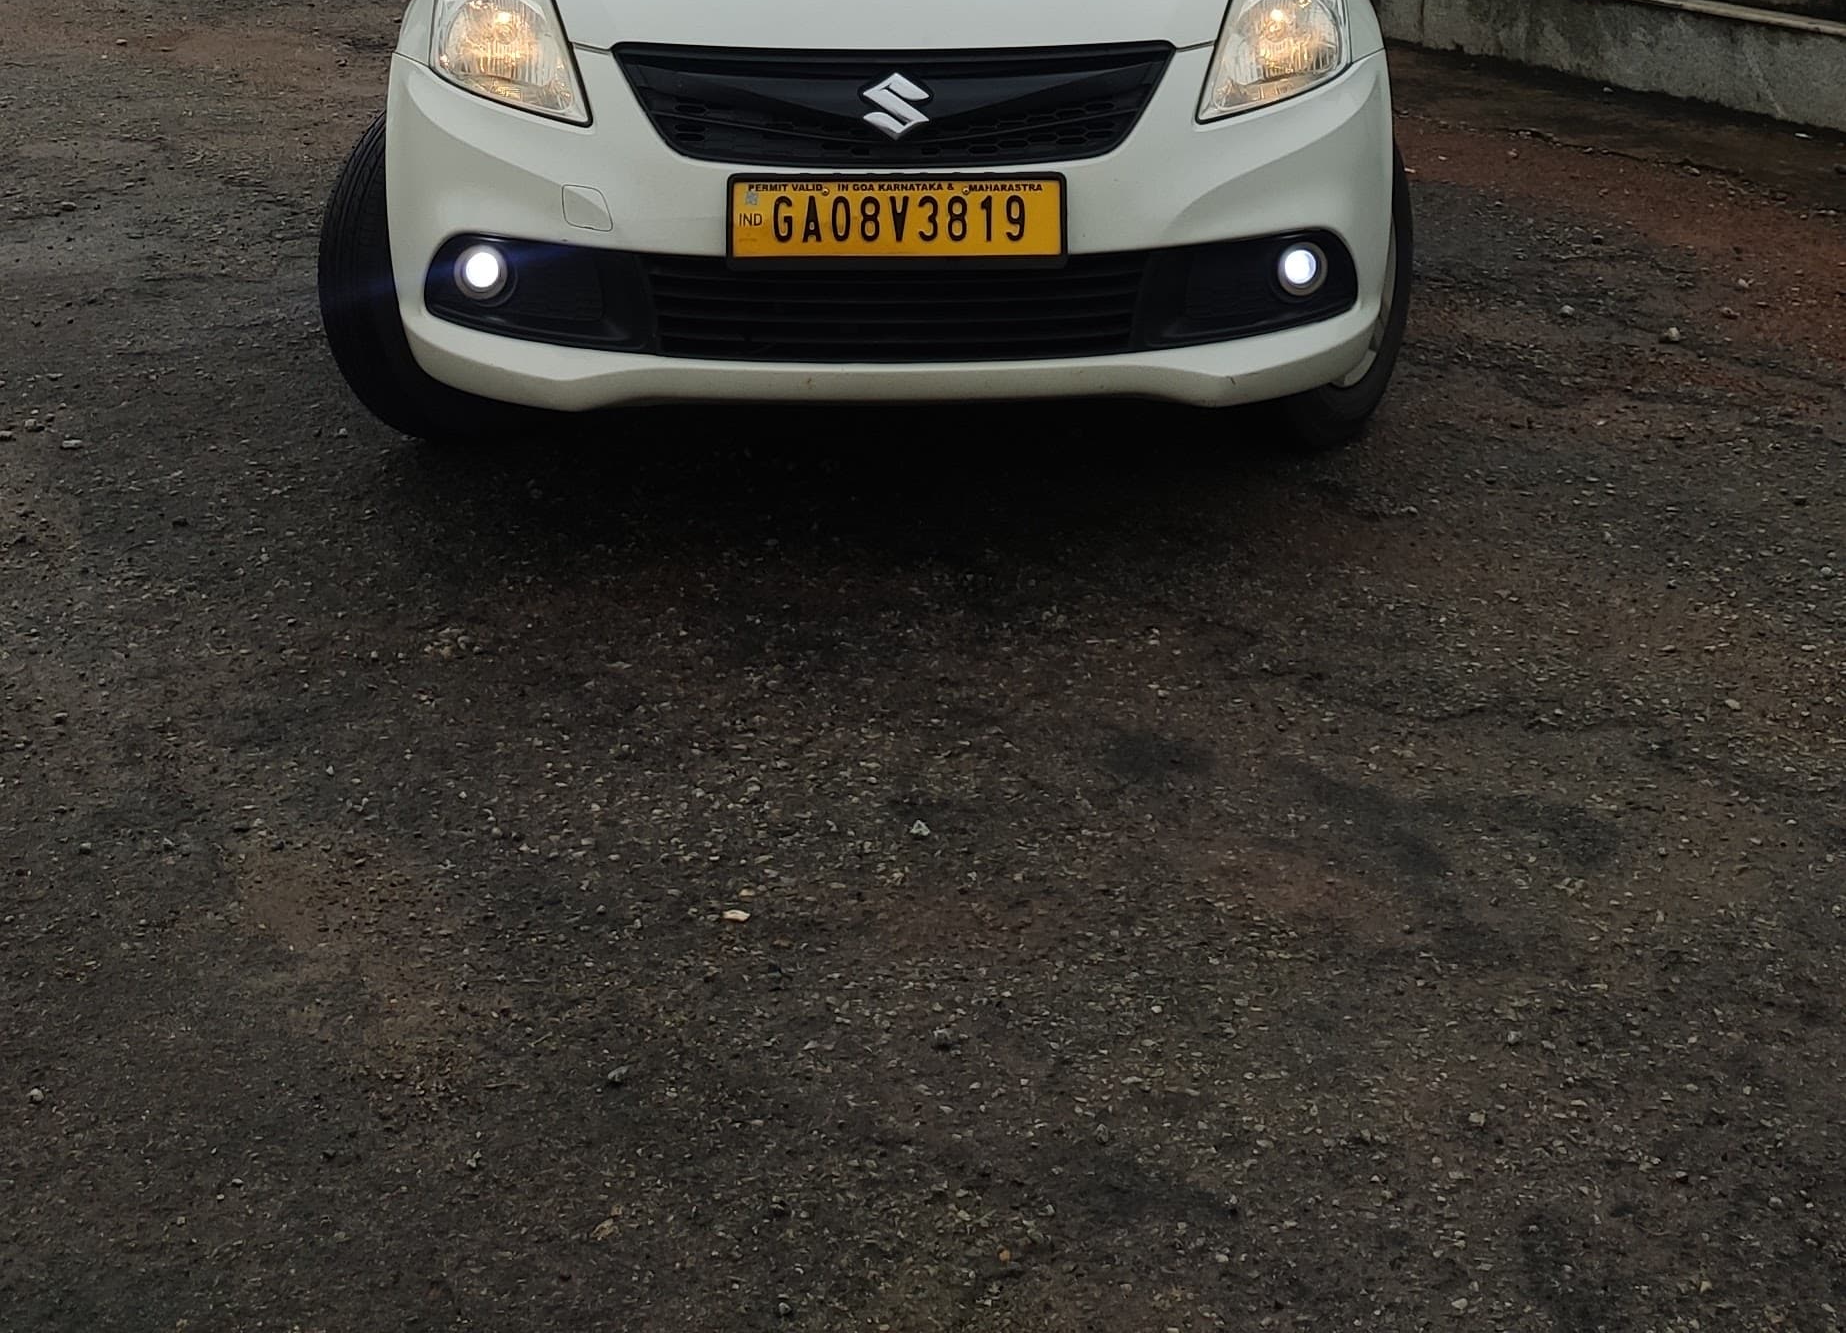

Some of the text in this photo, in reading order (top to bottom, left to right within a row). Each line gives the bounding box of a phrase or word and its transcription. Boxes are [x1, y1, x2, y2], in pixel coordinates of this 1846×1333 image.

[748, 183, 1043, 192] PERMIT VALID IN GOA KARNATAKA & MAHARASTRA
[739, 213, 763, 227] IND
[773, 194, 1025, 243] GA08V3819
